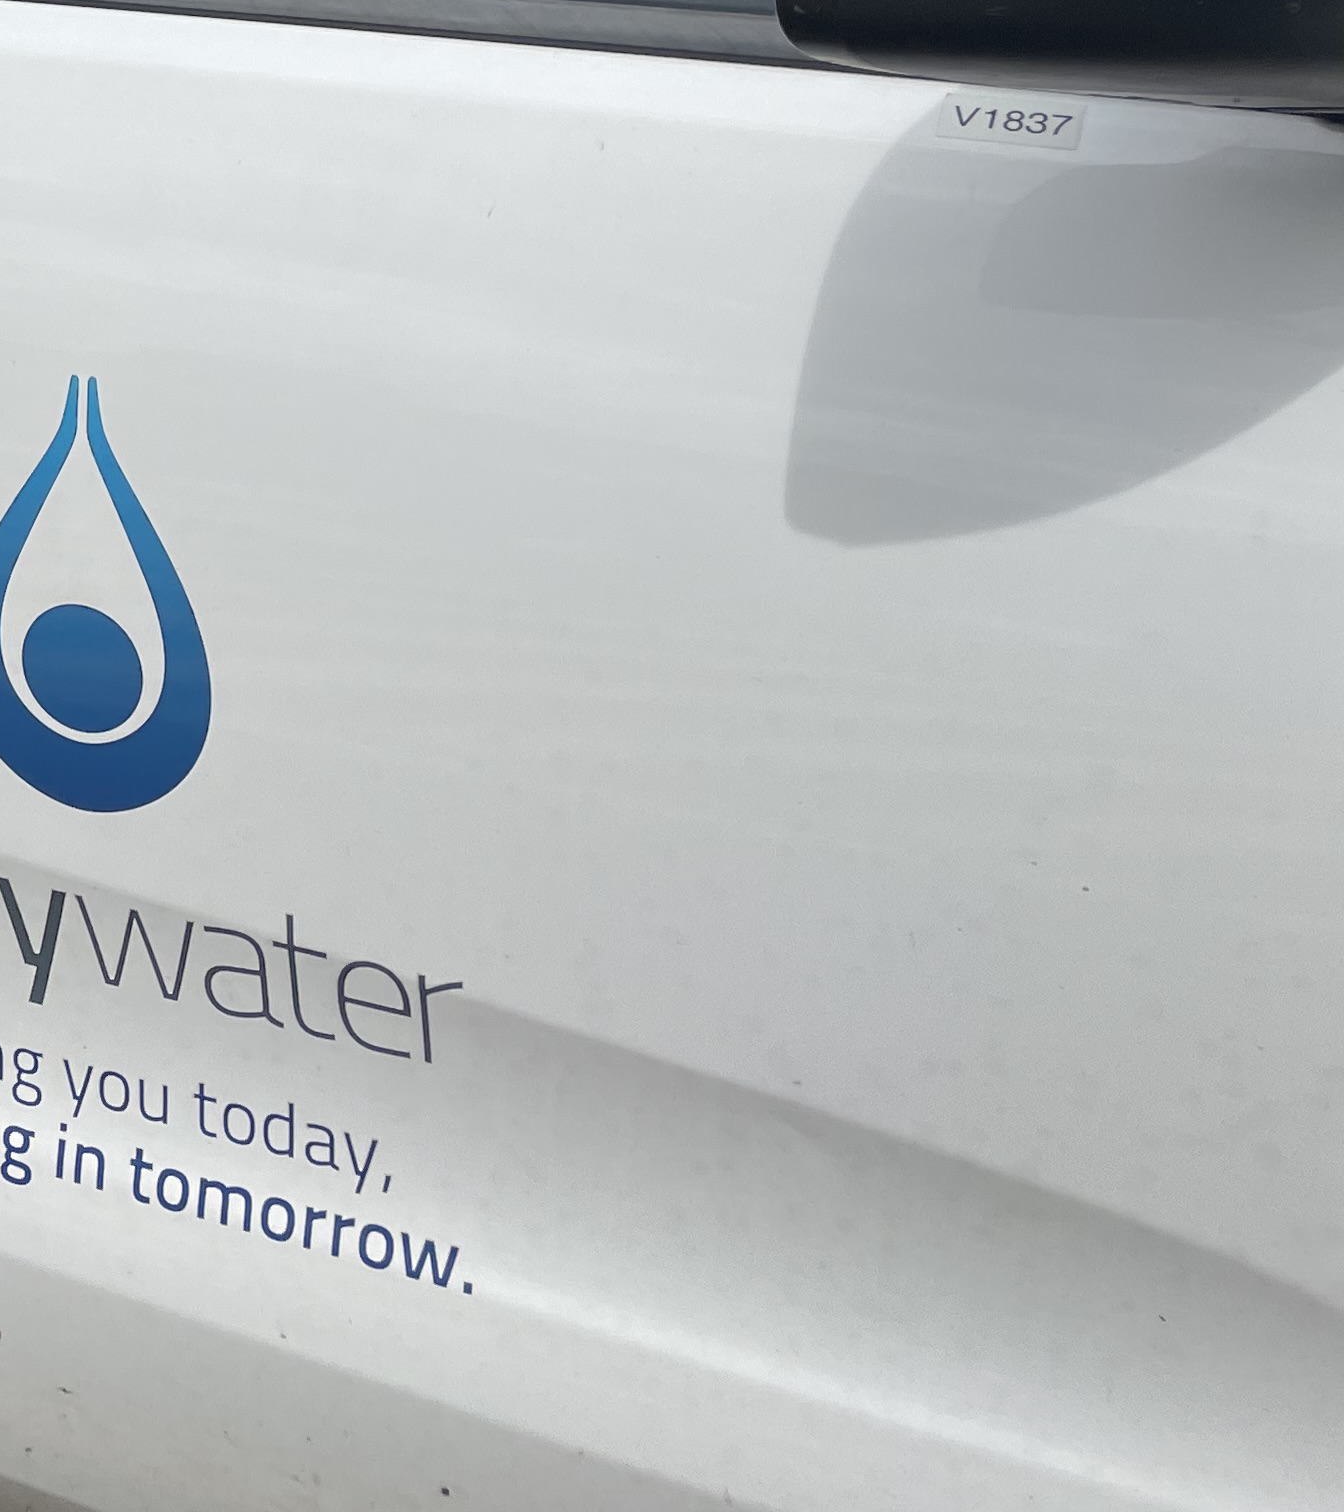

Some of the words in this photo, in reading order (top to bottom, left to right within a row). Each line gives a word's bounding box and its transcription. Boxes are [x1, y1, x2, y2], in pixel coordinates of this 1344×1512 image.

[955, 105, 1073, 136] V1837
[63, 1059, 169, 1123] you
[194, 1083, 392, 1194] today,
[55, 1123, 106, 1190] in
[130, 1148, 474, 1295] tomorrow.
